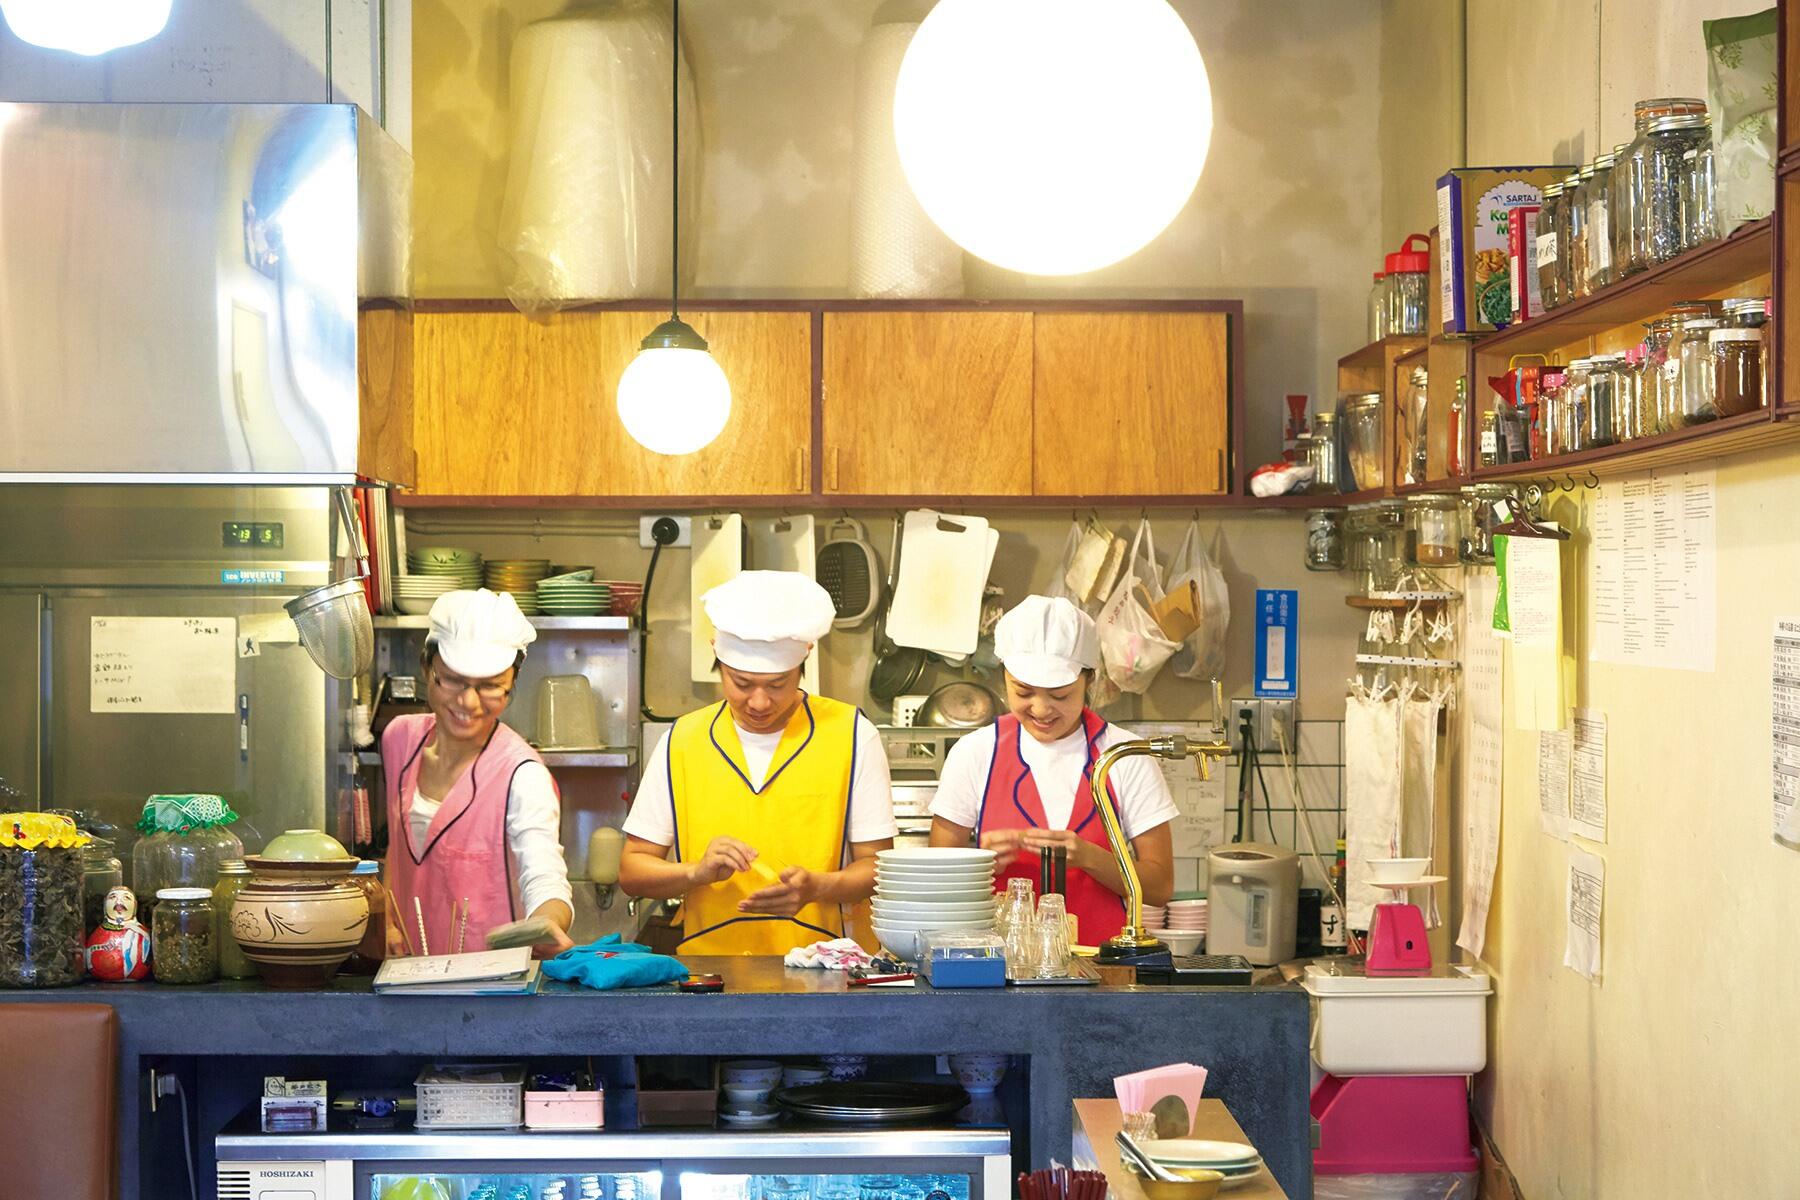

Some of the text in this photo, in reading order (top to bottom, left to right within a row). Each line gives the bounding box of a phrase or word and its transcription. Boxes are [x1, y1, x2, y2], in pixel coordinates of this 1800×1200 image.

[1506, 194, 1537, 202] SARTAJ
[240, 571, 282, 579] INVERTER
[1265, 593, 1274, 625] 責任者
[260, 1170, 314, 1178] HOSHIZAKI
